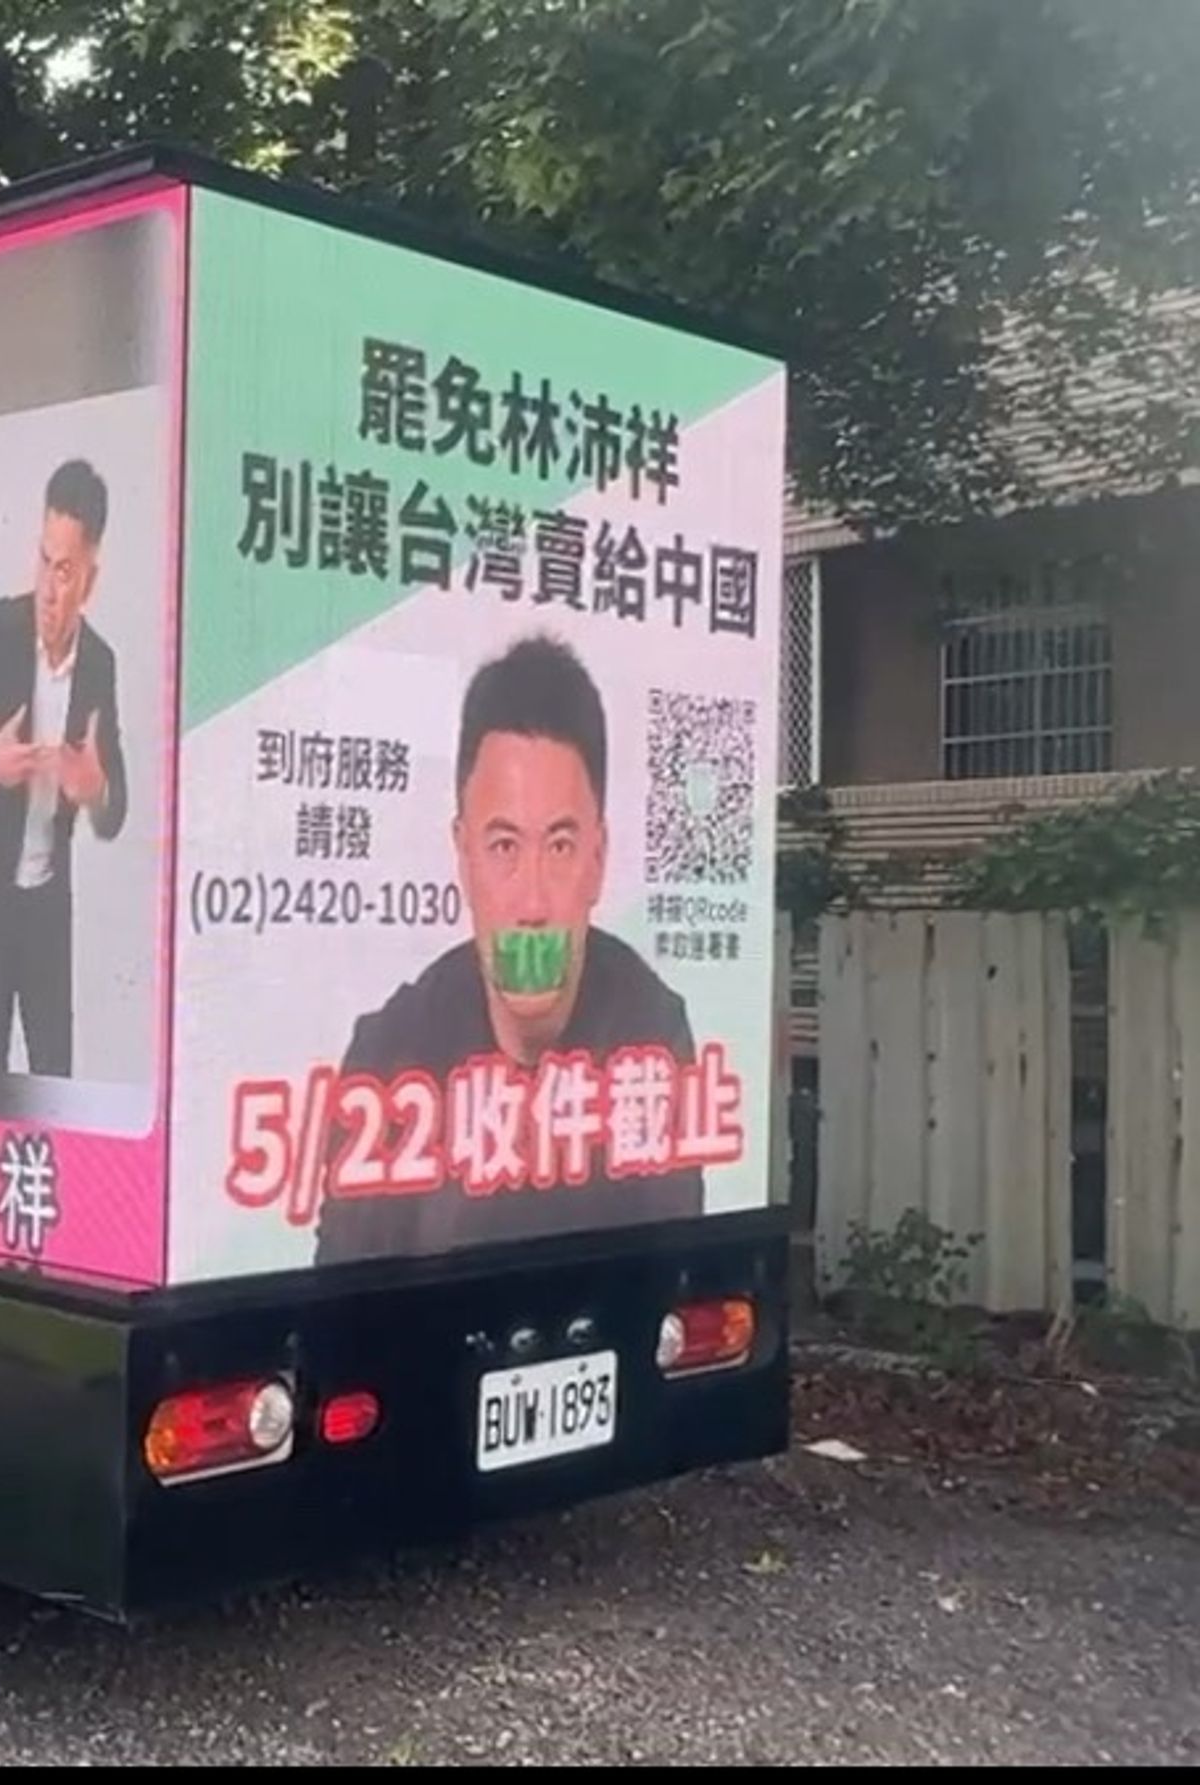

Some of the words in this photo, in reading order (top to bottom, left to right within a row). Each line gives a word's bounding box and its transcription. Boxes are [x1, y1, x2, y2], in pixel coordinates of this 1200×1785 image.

[359, 336, 681, 506] 罷免林沛祥
[237, 451, 759, 640] 別讓台灣賣給中國
[256, 729, 411, 794] 到府服務
[296, 804, 373, 861] 請撥
[190, 872, 462, 934] (02)2420-1030
